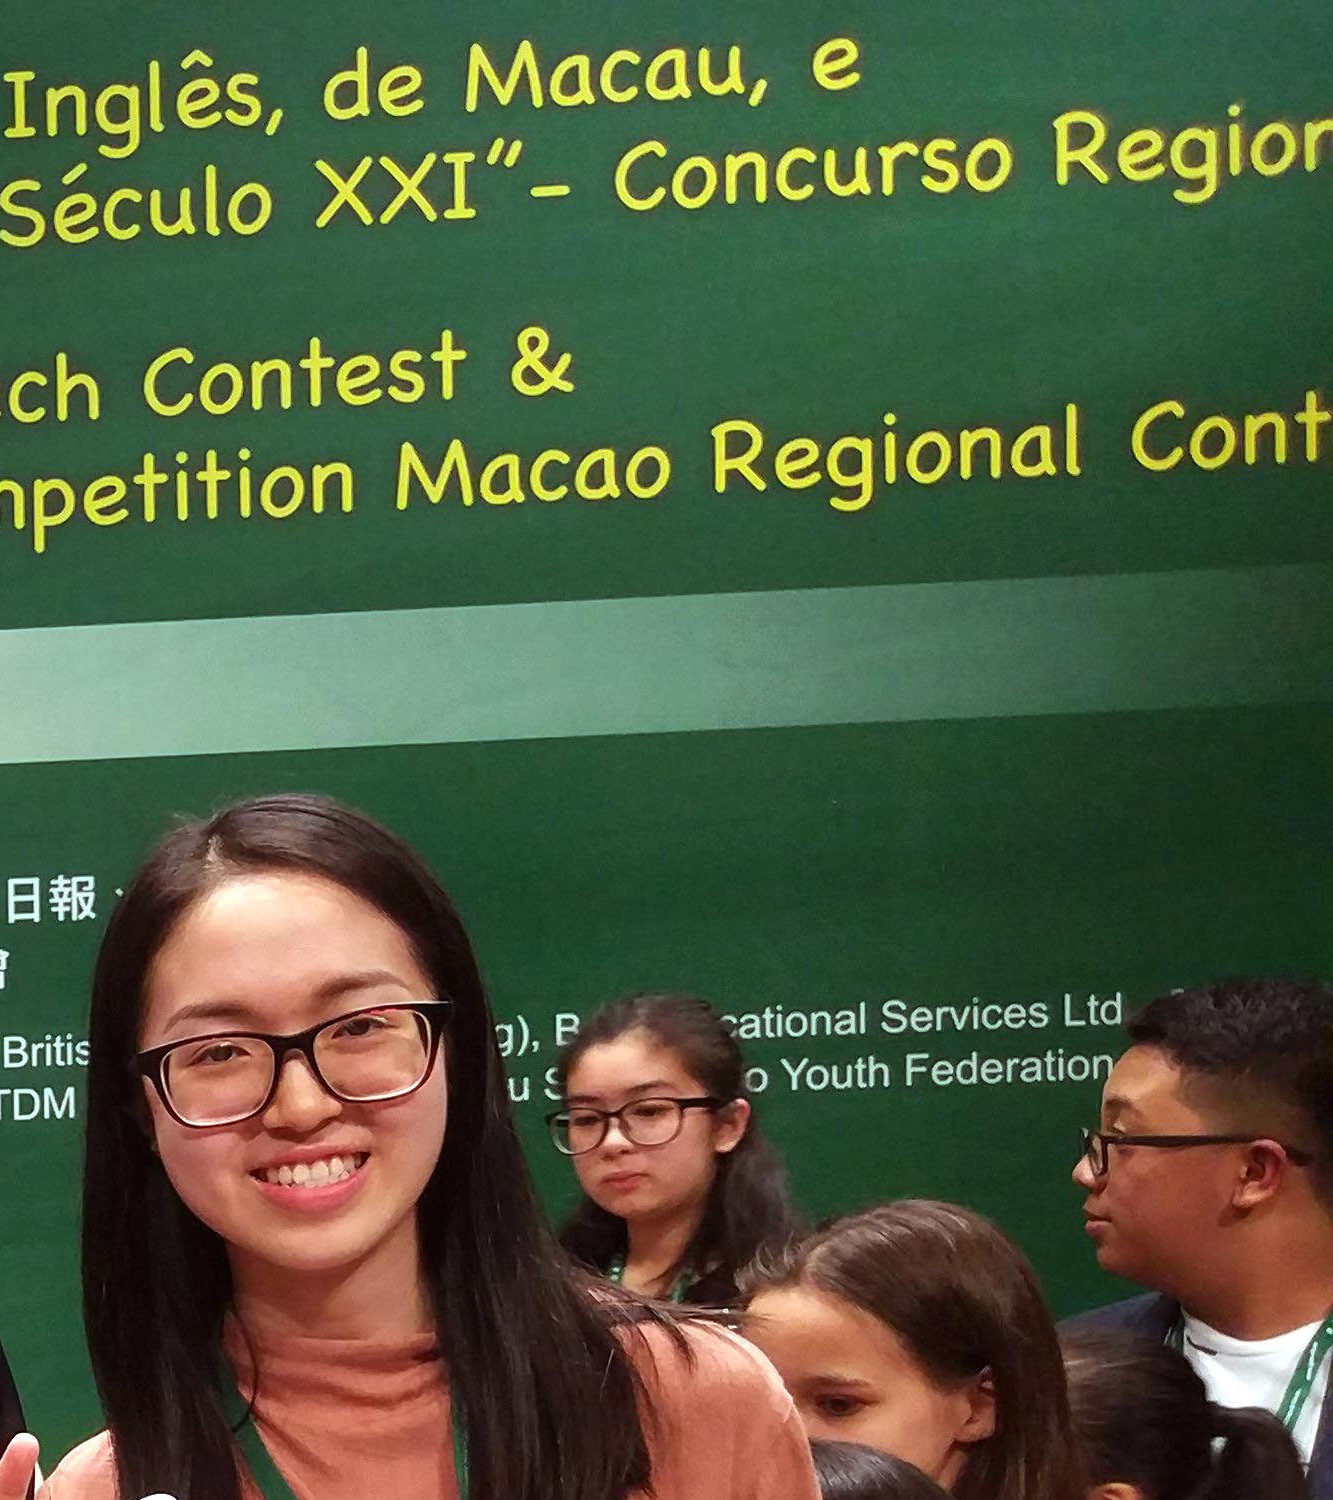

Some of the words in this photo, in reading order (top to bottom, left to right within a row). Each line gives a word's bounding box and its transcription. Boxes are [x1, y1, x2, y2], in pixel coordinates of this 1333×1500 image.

[3, 47, 285, 160] Inglês,
[322, 45, 426, 122] de
[464, 38, 769, 114] Macau,
[810, 36, 864, 92] e
[613, 135, 1016, 213] Concurso
[142, 328, 469, 418] Contest
[509, 324, 577, 398] &
[394, 437, 673, 512] Macao
[709, 401, 1083, 513] Regional
[3, 1032, 92, 1069] Britis
[719, 1000, 868, 1041] cational
[880, 996, 1050, 1034] Services
[1064, 991, 1123, 1028] Ltd
[780, 1052, 892, 1091] Youth
[904, 1046, 1114, 1088] Federation
